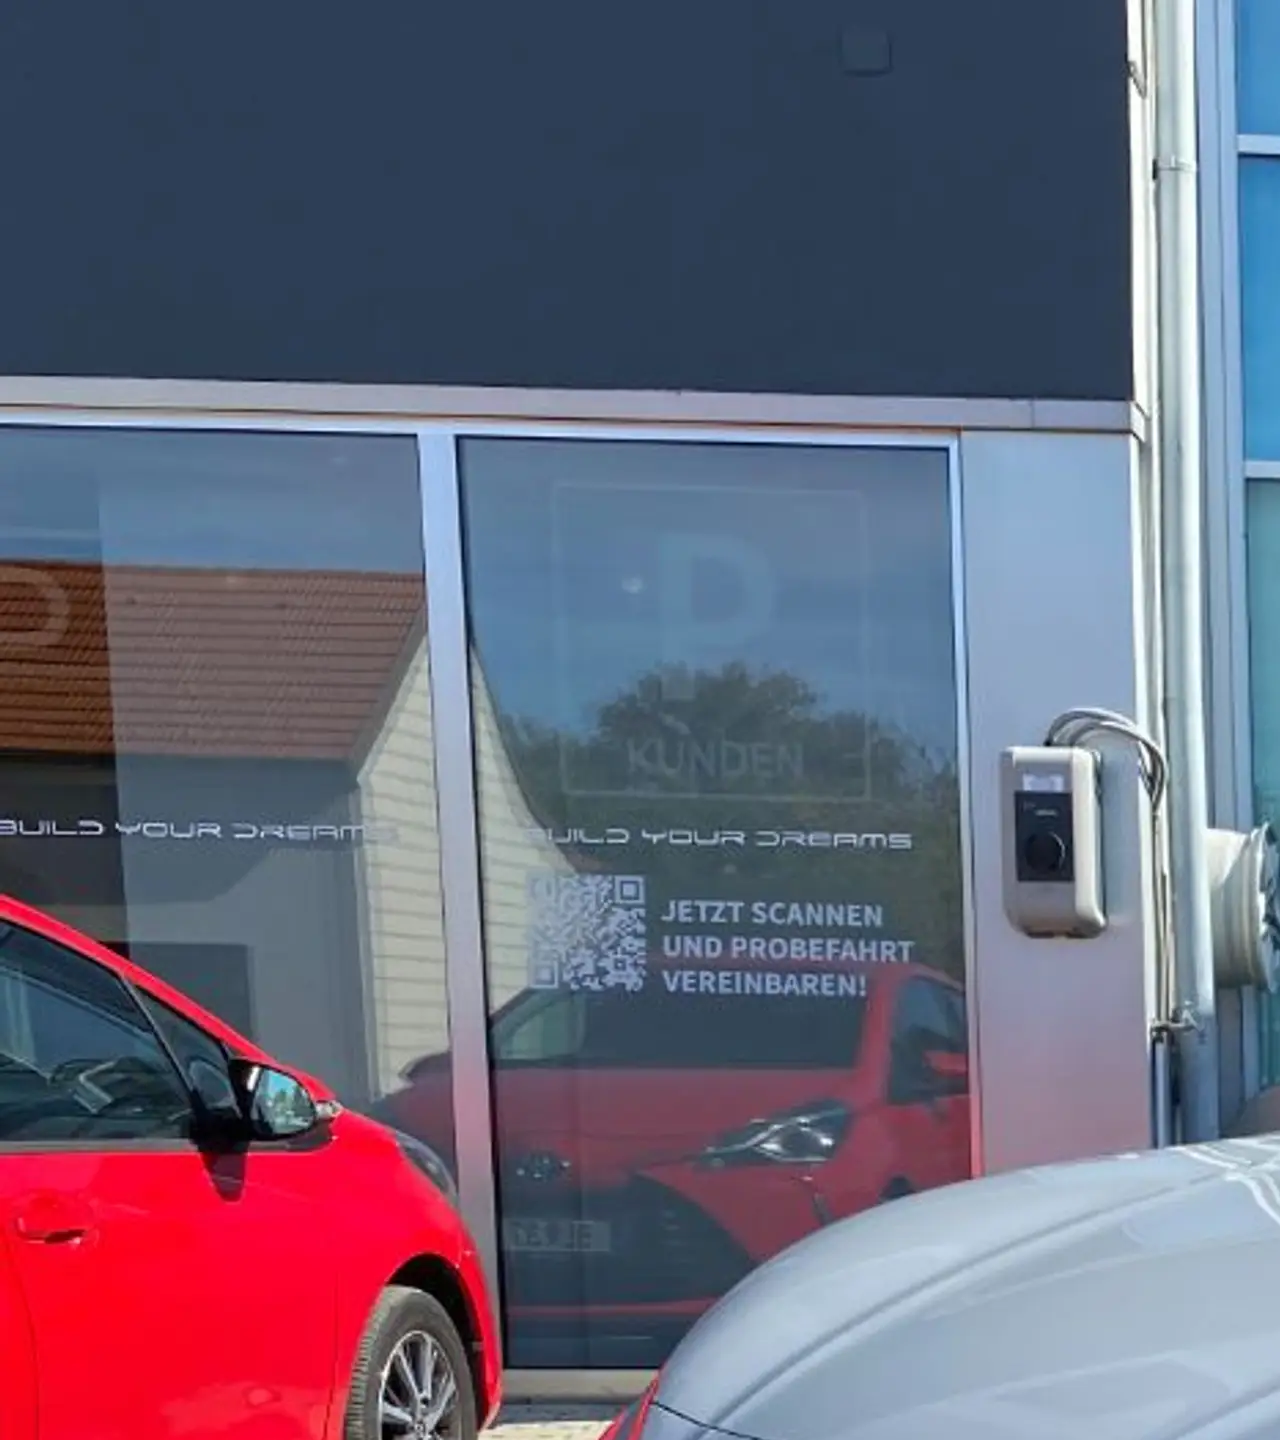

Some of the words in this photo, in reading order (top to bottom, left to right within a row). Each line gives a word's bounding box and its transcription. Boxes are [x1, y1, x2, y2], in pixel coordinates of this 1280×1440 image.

[626, 737, 804, 777] KUNDEN
[115, 822, 222, 838] YOUR
[641, 828, 745, 846] YOUR
[755, 831, 912, 849] DREAMS
[661, 900, 744, 923] JETZT
[752, 902, 883, 927] SCANNEN
[663, 935, 722, 959] UND
[731, 938, 915, 964] PROBEFAHRT
[662, 970, 867, 997] VEREINBAREN!
